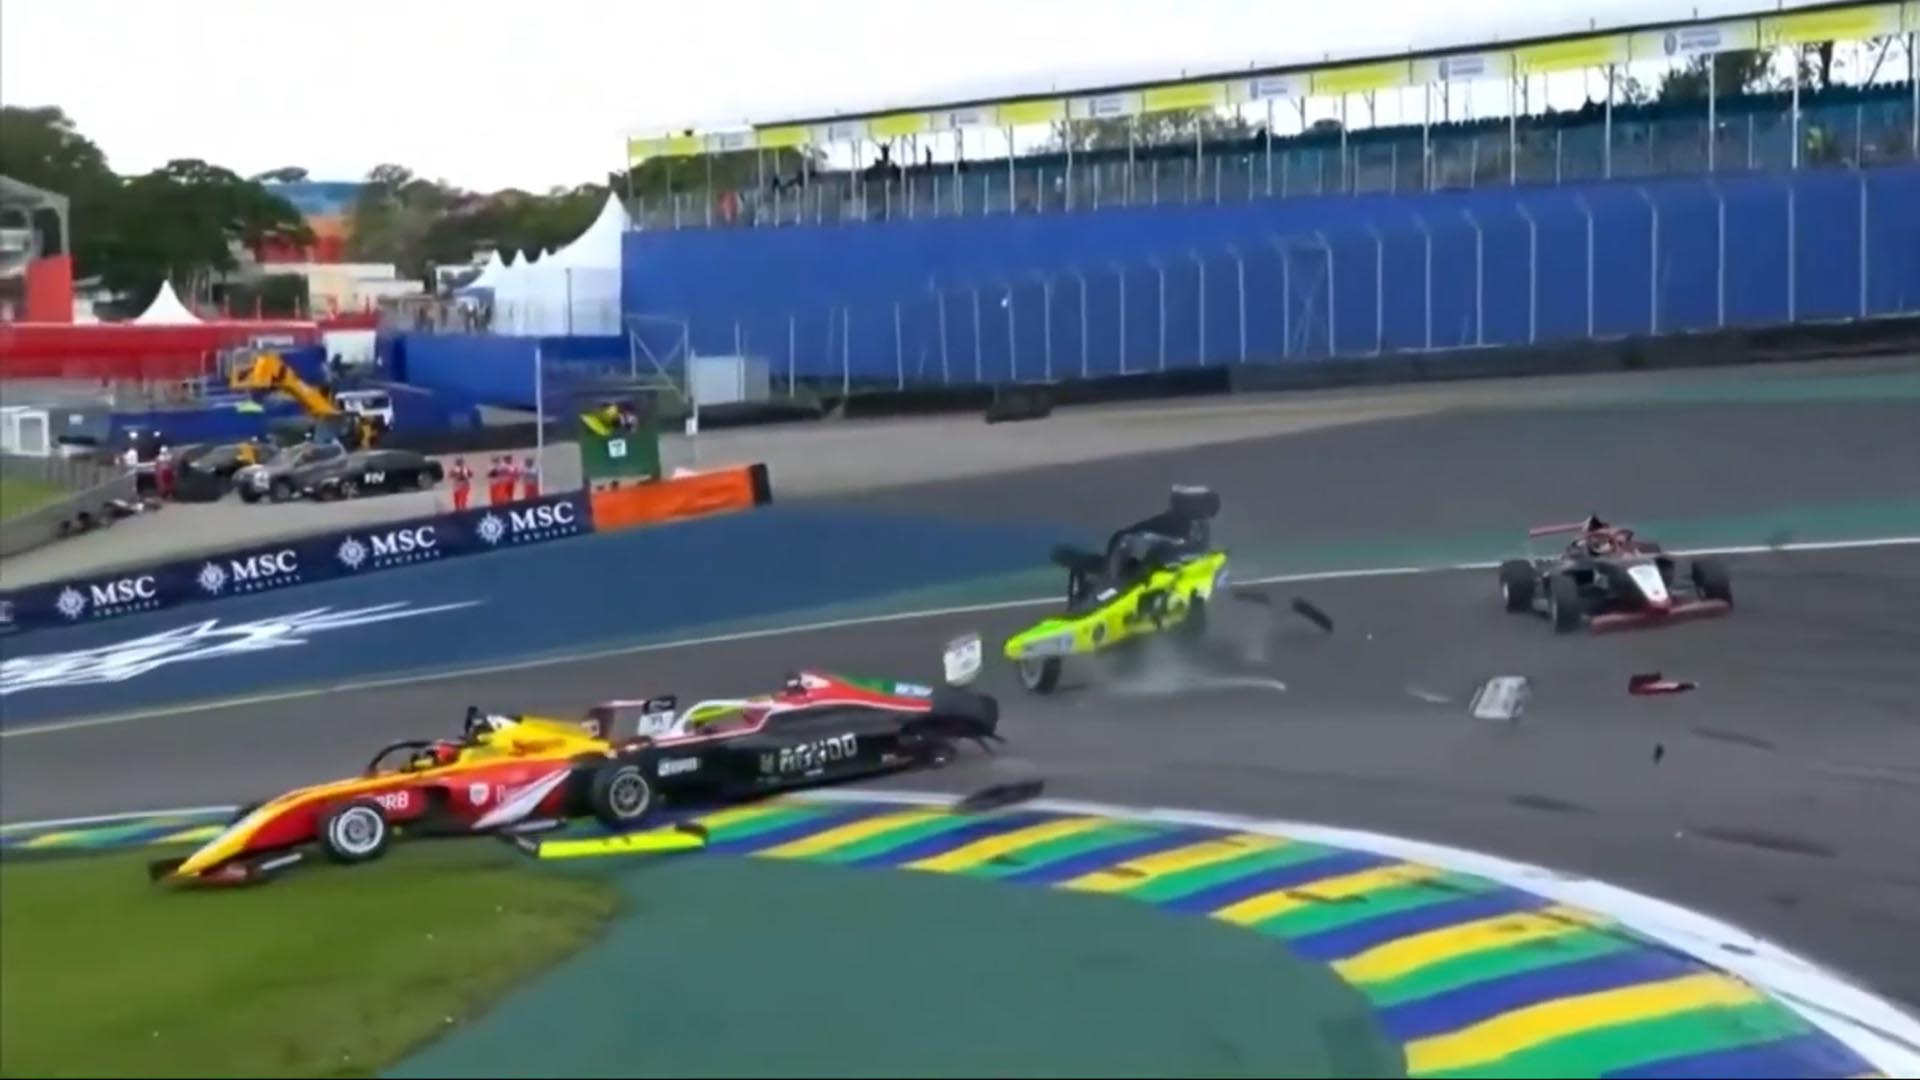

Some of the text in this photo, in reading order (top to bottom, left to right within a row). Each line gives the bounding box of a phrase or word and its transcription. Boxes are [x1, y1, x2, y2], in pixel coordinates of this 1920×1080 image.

[509, 501, 575, 532] MSC
[370, 526, 436, 556] MSC
[231, 549, 298, 581] MSC
[90, 576, 156, 606] MSC
